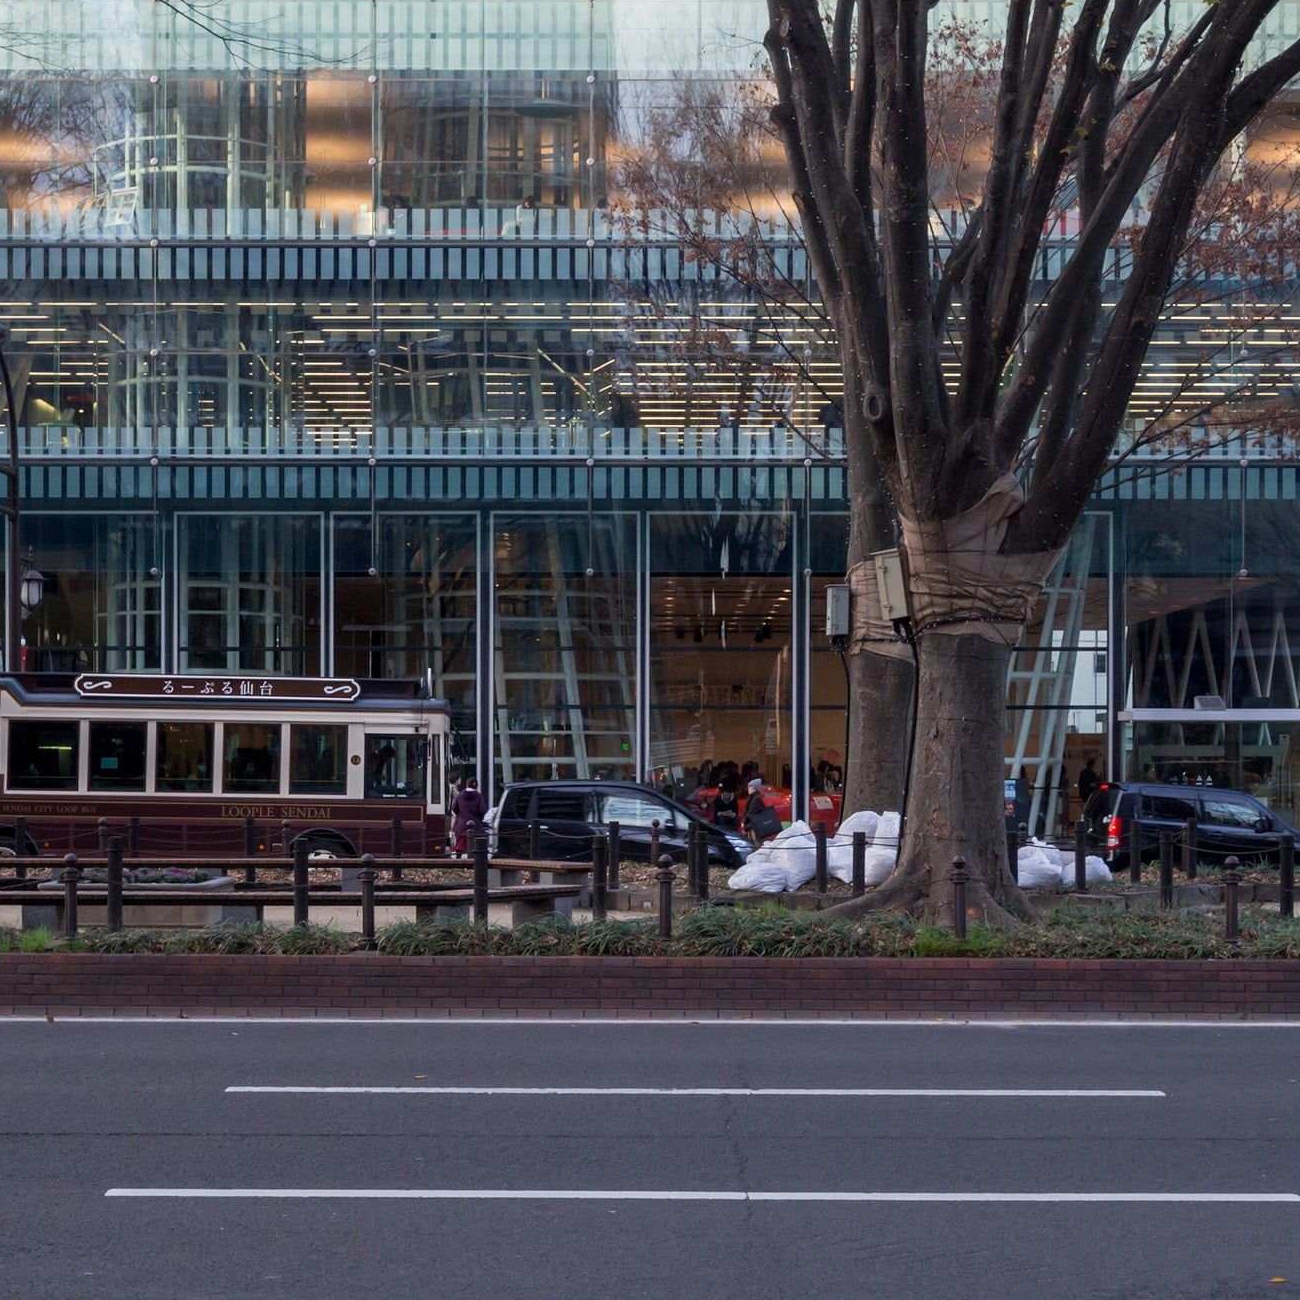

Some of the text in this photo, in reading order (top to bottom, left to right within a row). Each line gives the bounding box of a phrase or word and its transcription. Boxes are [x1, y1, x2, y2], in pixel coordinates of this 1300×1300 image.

[162, 680, 274, 696] るーぷる仙台
[2, 804, 97, 813] SENDAI CITY LOOP BUS
[221, 805, 332, 818] LOOPLE SENDAI
